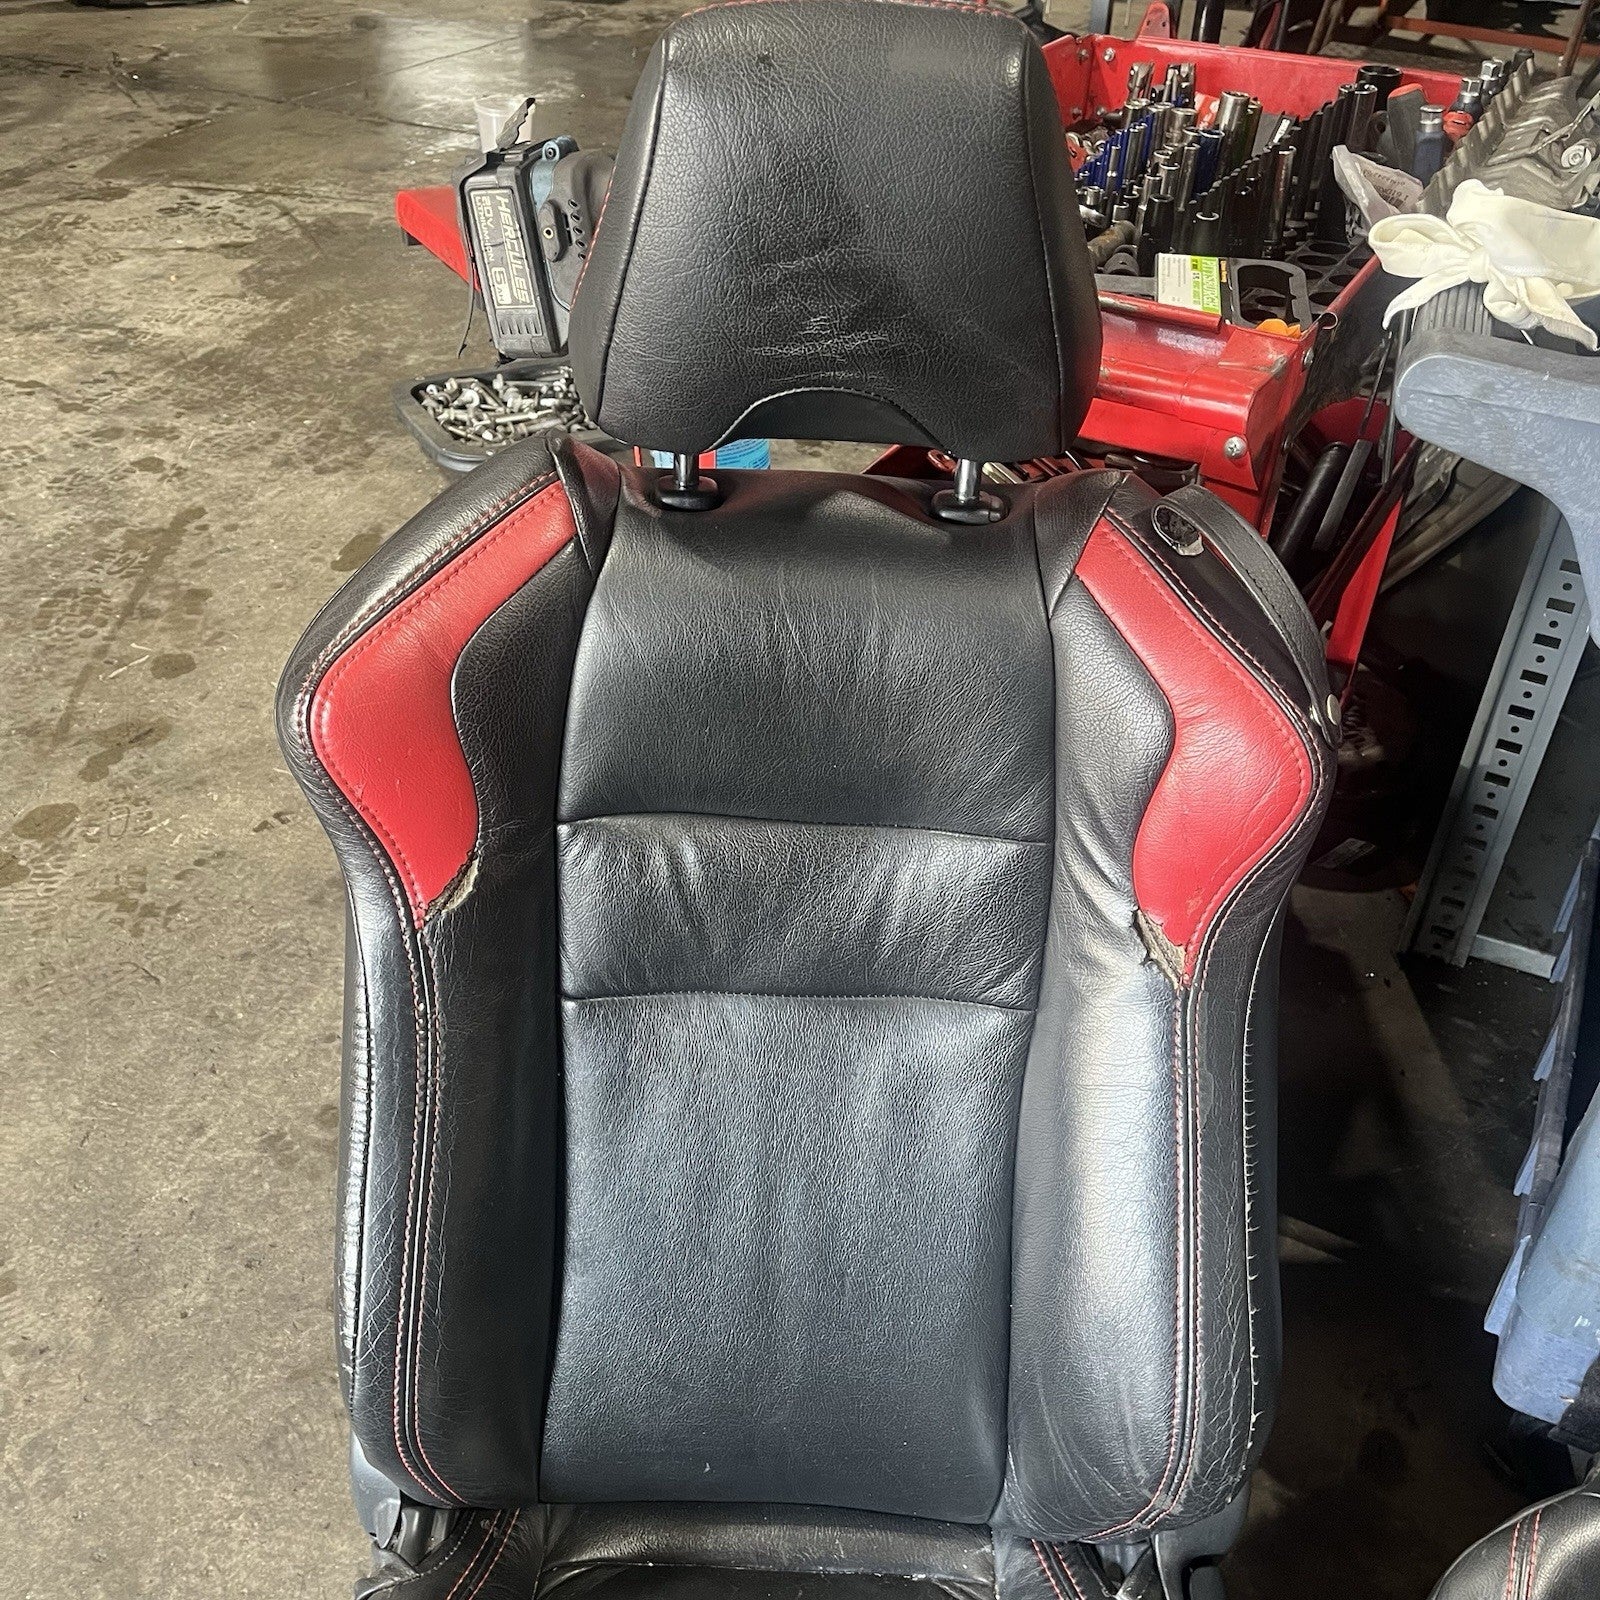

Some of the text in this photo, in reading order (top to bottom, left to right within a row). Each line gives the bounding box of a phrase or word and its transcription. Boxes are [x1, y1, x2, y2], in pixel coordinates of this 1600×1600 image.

[481, 195, 495, 228] 20V
[496, 195, 530, 304] HERCULES
[1202, 258, 1218, 308] PITTSBURGH
